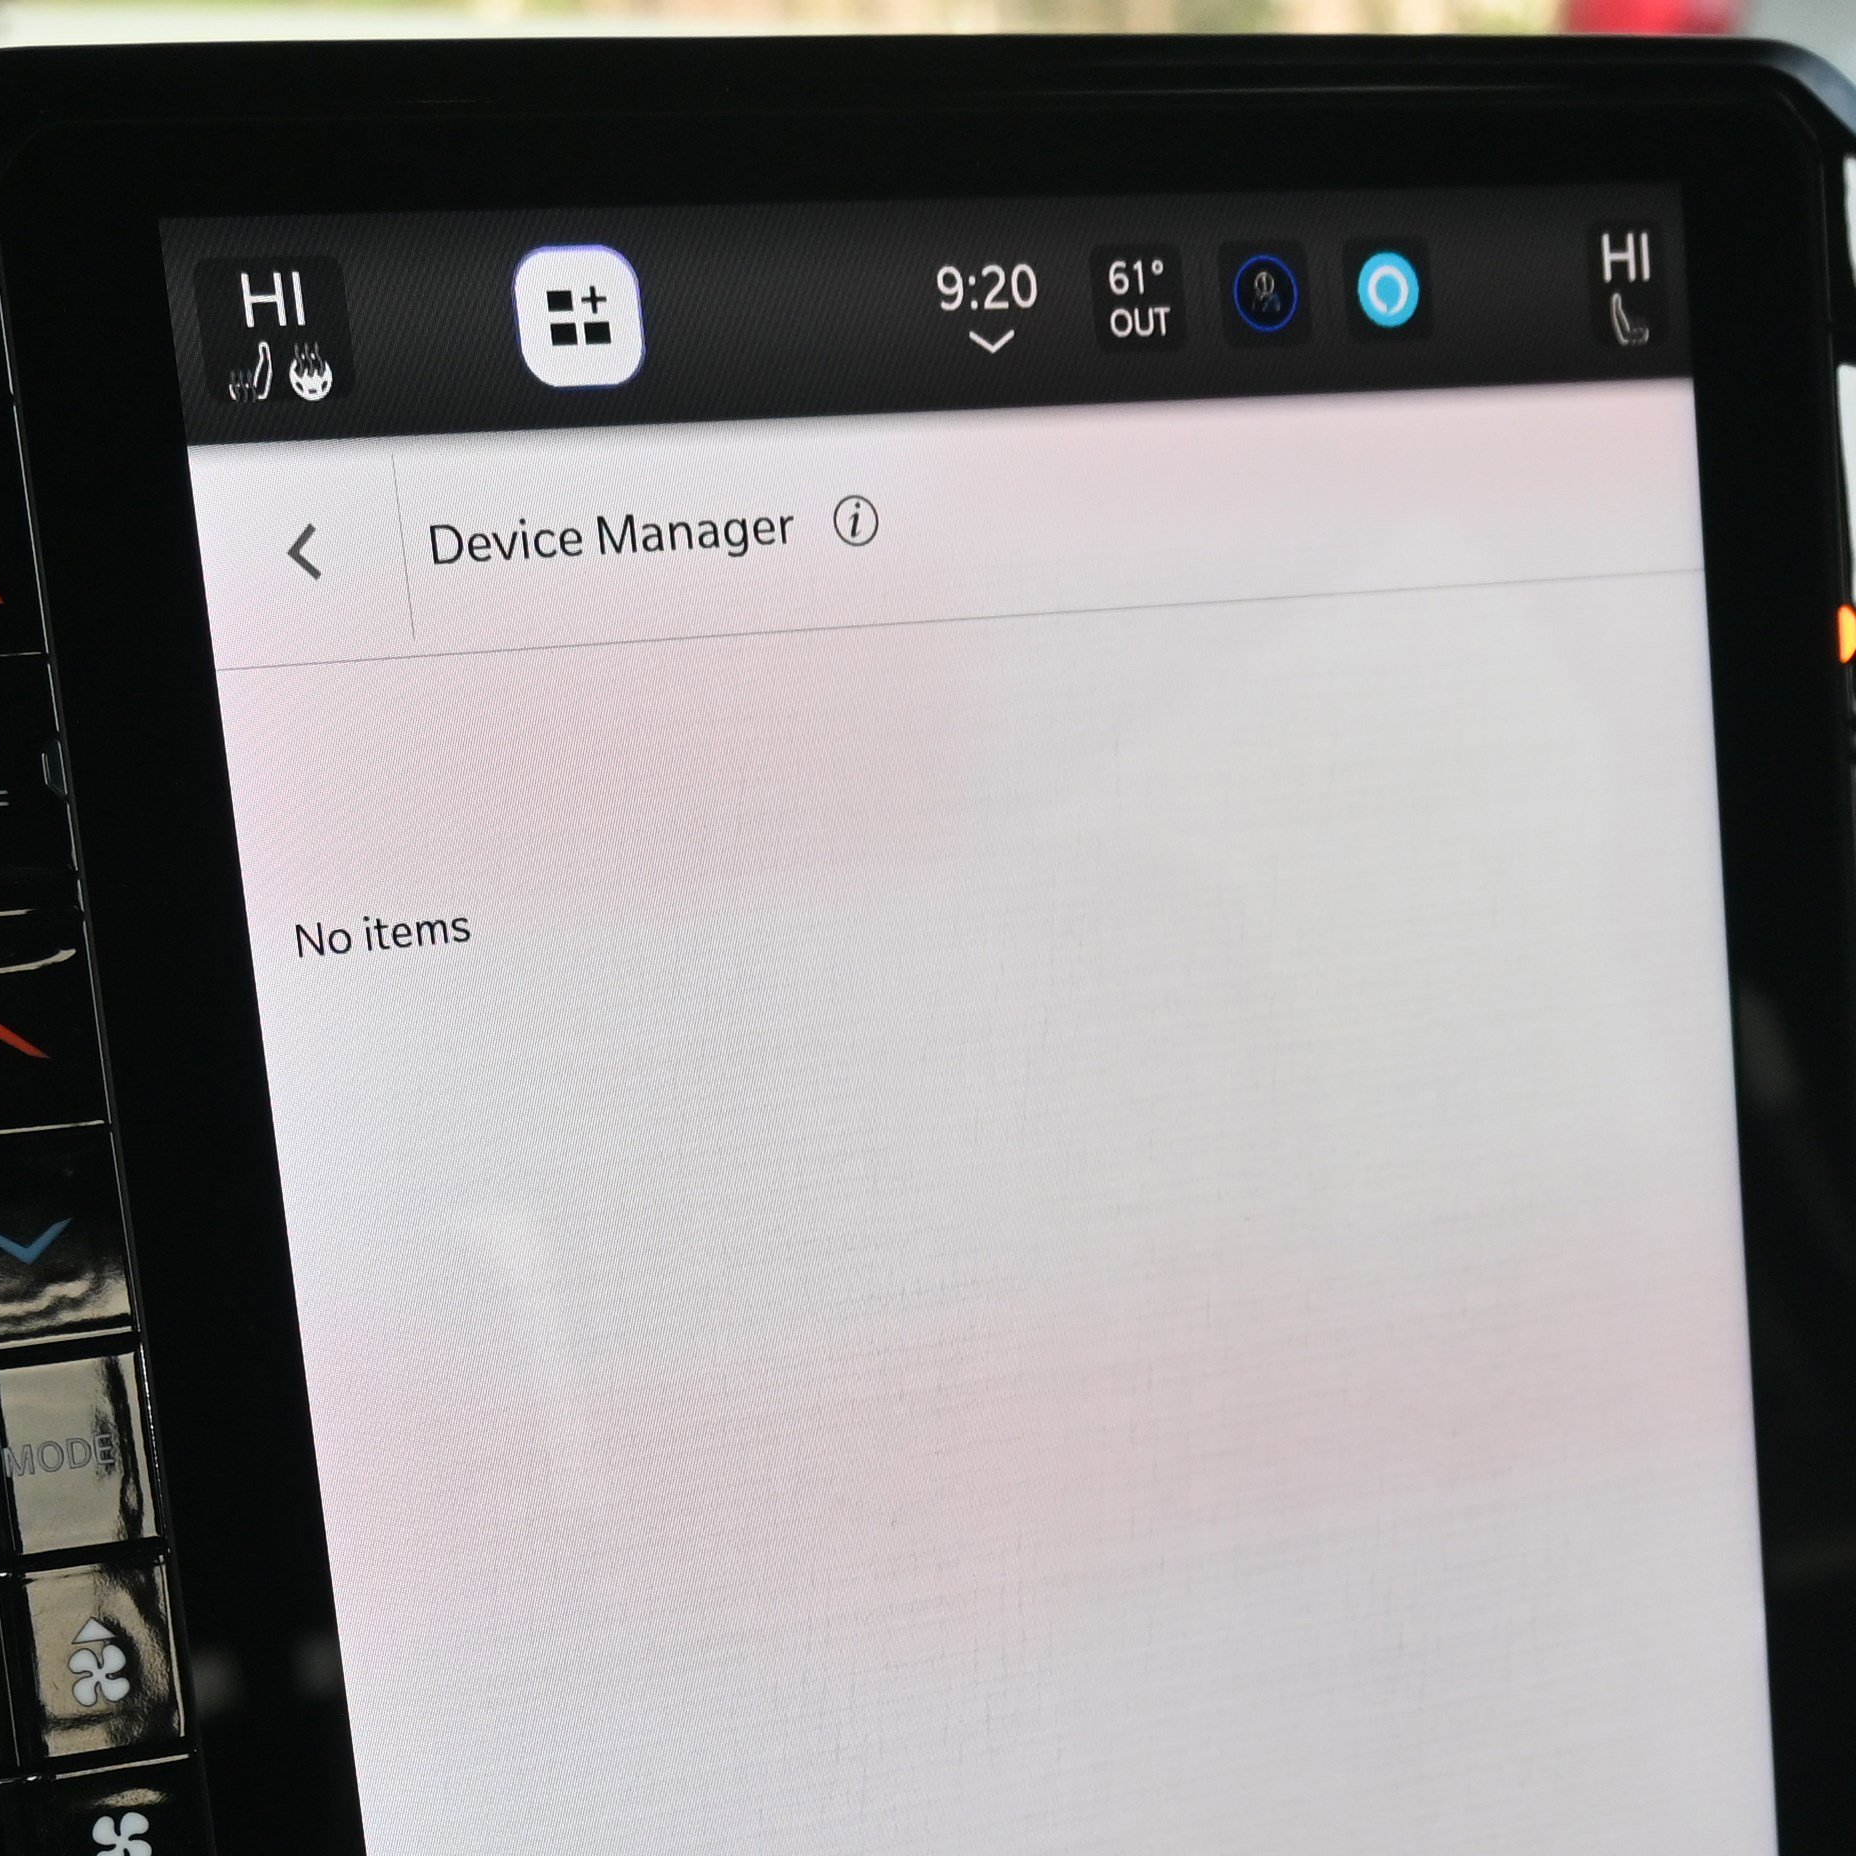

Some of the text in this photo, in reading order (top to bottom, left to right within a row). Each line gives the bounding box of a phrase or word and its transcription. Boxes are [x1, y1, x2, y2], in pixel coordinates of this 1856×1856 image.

[1599, 230, 1652, 285] HI
[239, 269, 307, 329] HI
[935, 261, 1038, 315] 9:20
[1109, 306, 1171, 339] OUT
[427, 507, 796, 566] Device Manager
[294, 910, 472, 959] No items
[1, 1430, 118, 1480] MODE
